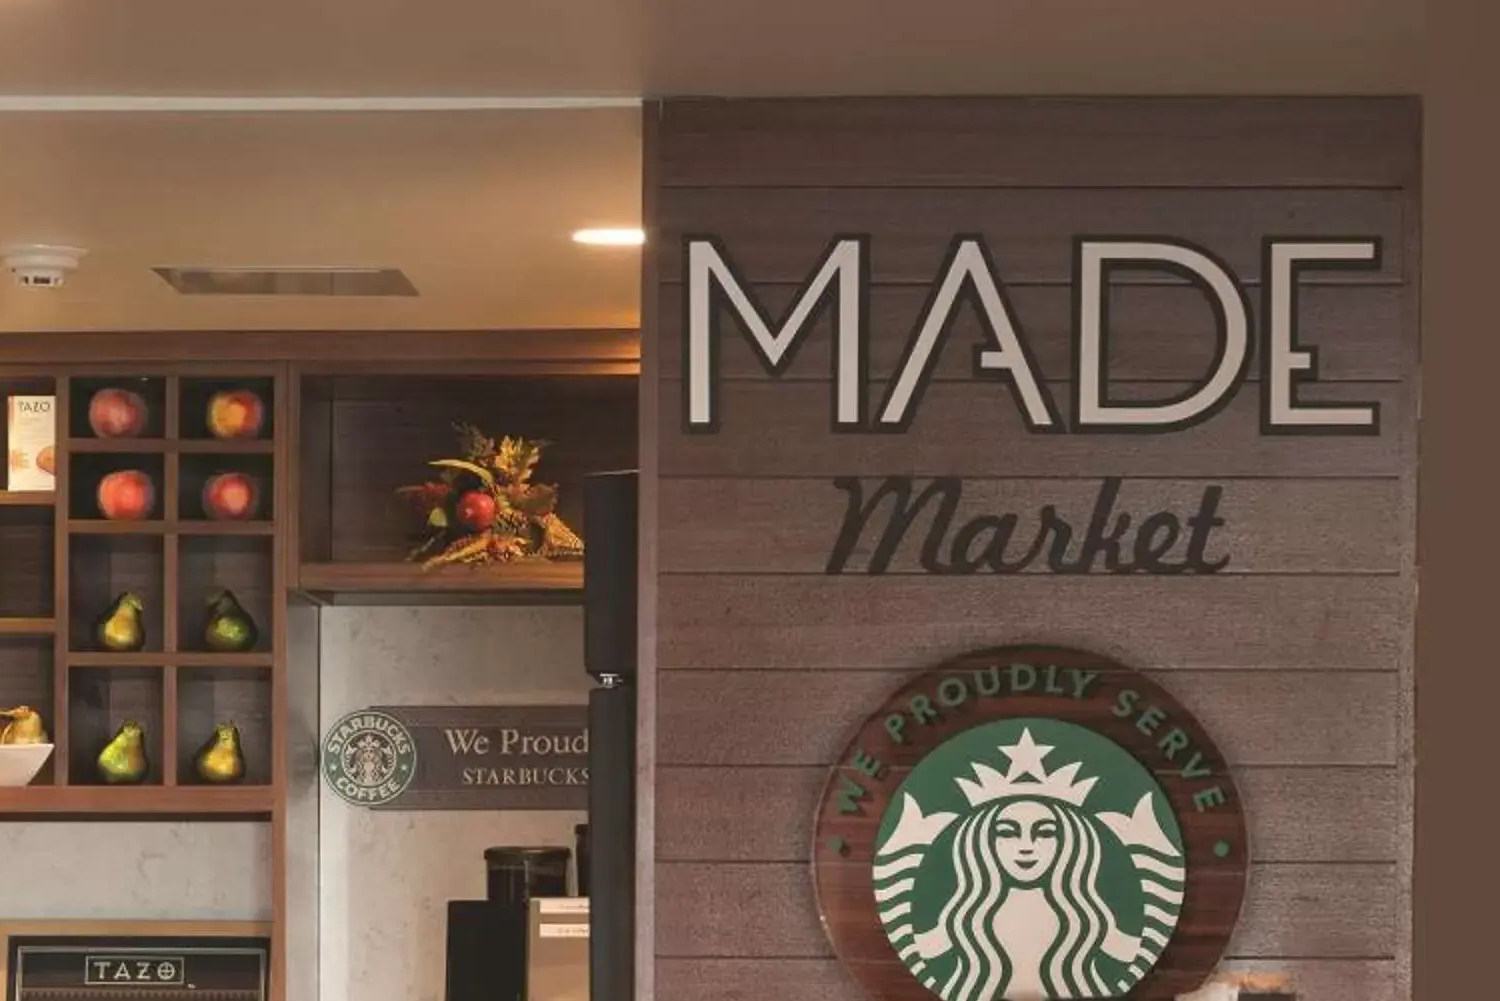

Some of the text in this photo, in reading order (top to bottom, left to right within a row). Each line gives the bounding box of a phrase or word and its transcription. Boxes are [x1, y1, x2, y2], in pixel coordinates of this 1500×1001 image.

[682, 234, 1381, 434] MADE
[18, 401, 51, 412] TAZO
[825, 474, 1231, 575] Market
[327, 715, 411, 754] STARBUCKS
[445, 729, 489, 755] We
[836, 663, 1227, 815] WE PROUDLY SERVE
[336, 777, 400, 801] COFFEE
[93, 961, 176, 980] TAZO
